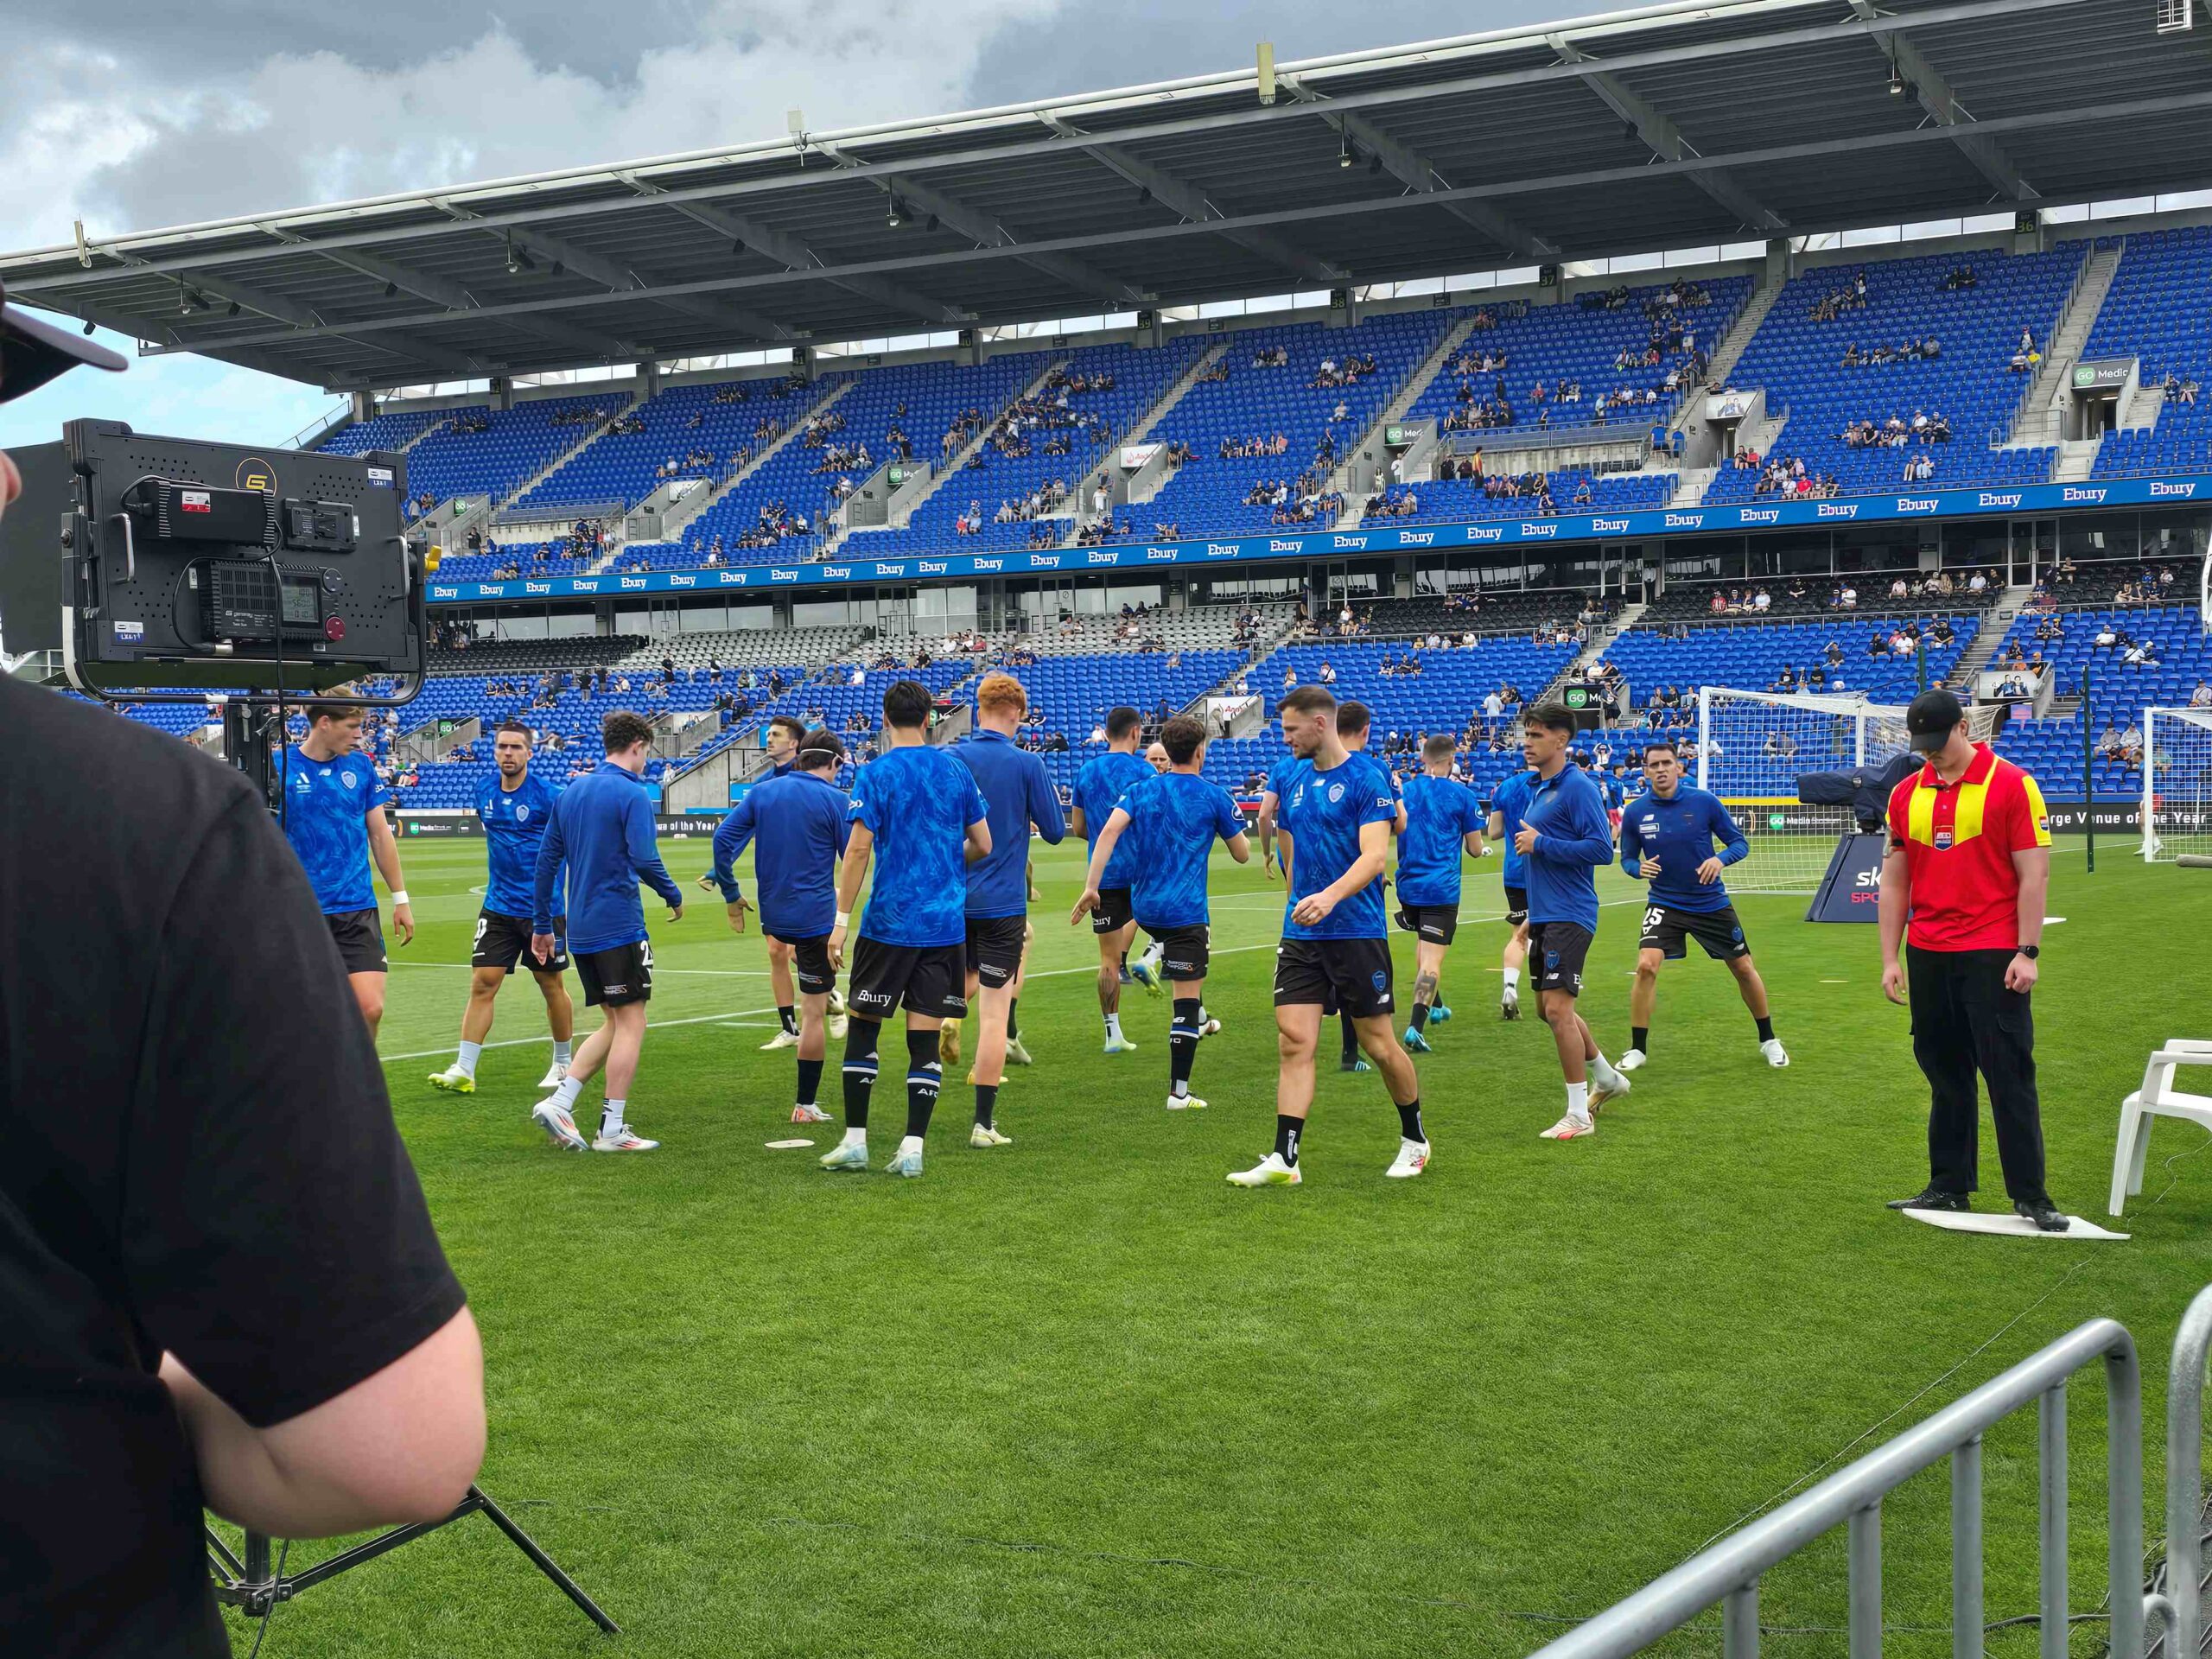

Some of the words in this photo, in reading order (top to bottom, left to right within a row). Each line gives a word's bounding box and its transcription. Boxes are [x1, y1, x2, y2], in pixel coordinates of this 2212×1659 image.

[2077, 371, 2094, 380] GO
[435, 588, 457, 598] Ebury
[480, 585, 503, 595] Ebury
[526, 582, 550, 594] Ebury
[574, 581, 598, 591] Ebury
[621, 578, 646, 588] Ebury
[671, 575, 696, 586] Ebury
[721, 572, 747, 584] Ebury
[772, 570, 798, 581] Ebury
[824, 567, 850, 578] Ebury
[877, 564, 904, 575] Ebury
[919, 562, 947, 573] Ebury
[975, 558, 1002, 569] Ebury
[1031, 556, 1059, 567] Ebury
[1089, 552, 1118, 563] Ebury
[1147, 549, 1178, 560] Ebury
[1208, 544, 1239, 556] Ebury
[1270, 540, 1302, 552] Ebury
[1334, 537, 1367, 549] Ebury
[1400, 532, 1433, 544] Ebury
[1468, 528, 1502, 540] Ebury
[1522, 524, 1557, 537] Ebury
[1592, 519, 1629, 532] Ebury
[1665, 514, 1703, 527] Ebury
[1741, 509, 1779, 522] Ebury
[1818, 505, 1858, 518] Ebury
[1897, 499, 1939, 512] Ebury
[1980, 493, 2022, 507] Ebury
[2063, 488, 2107, 502] Ebury
[2150, 483, 2196, 496] Ebury
[1569, 693, 1586, 702] GO
[1786, 817, 1810, 825] Media
[2076, 812, 2120, 823] Vnue
[2126, 812, 2140, 823] of
[2173, 812, 2207, 823] Year
[696, 820, 715, 830] Year
[1856, 866, 1882, 887] sk
